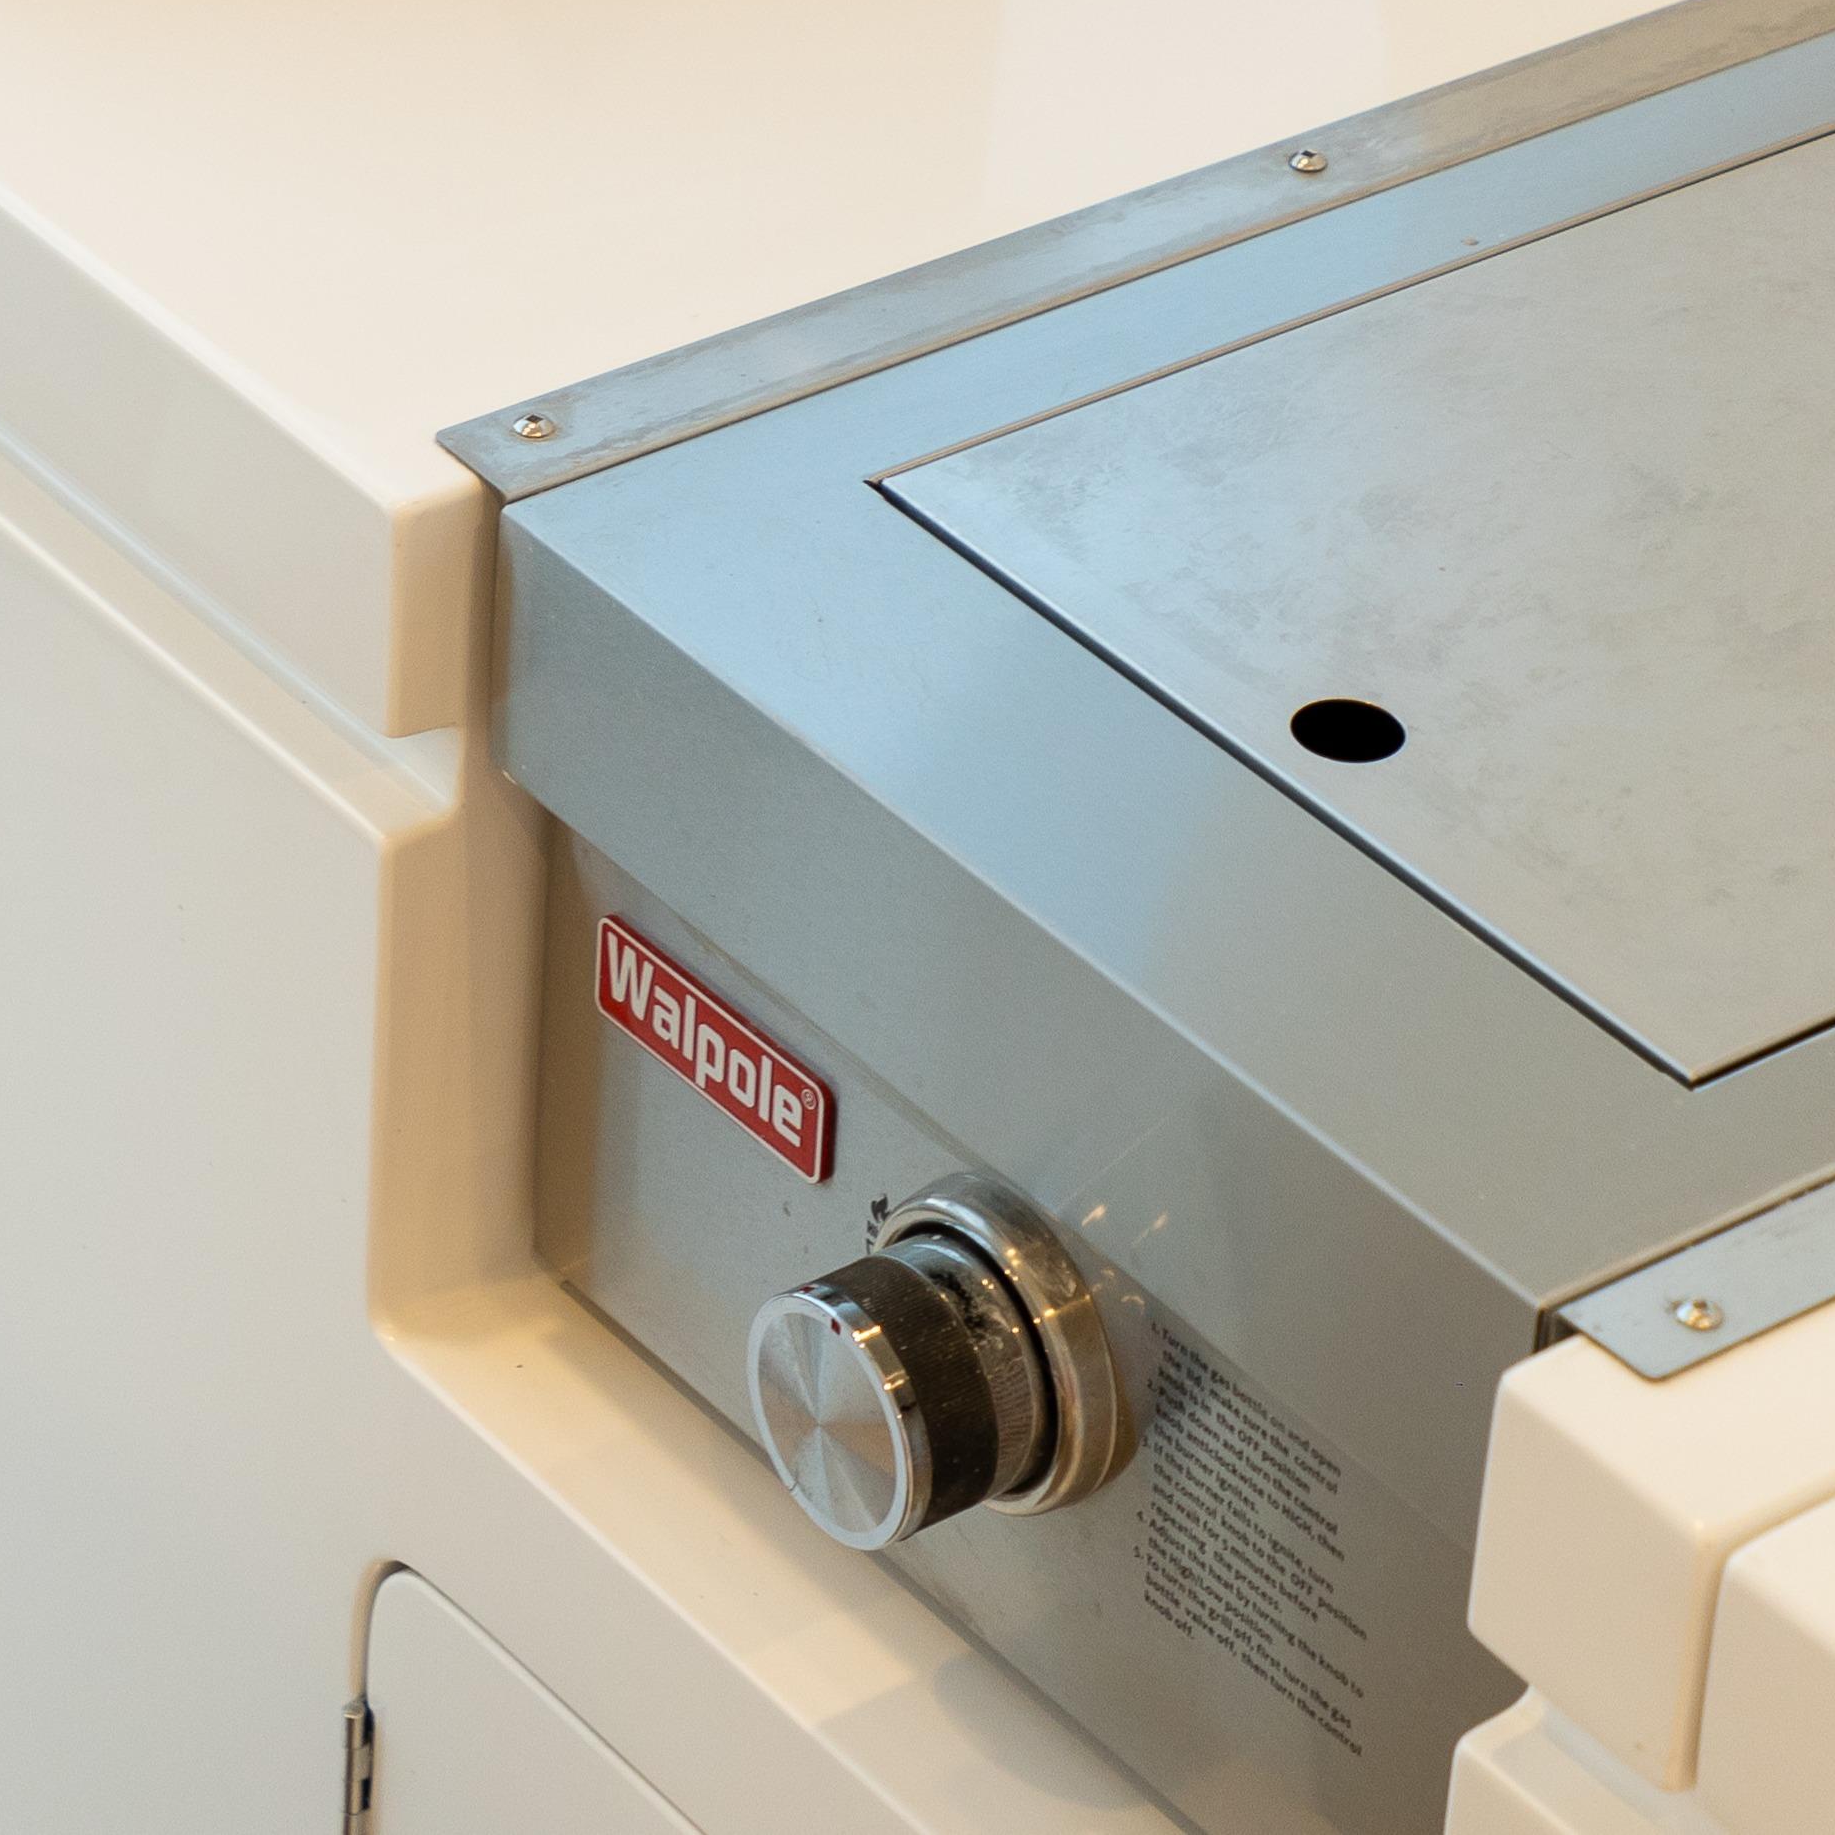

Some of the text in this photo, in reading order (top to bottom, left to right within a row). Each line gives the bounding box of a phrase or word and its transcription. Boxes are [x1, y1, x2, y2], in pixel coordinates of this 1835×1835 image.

[1154, 1423, 1172, 1445] the
[1175, 1439, 1213, 1475] burner
[1158, 1367, 1187, 1395] knob
[1216, 1413, 1235, 1433] the
[1237, 1430, 1259, 1450] OFF
[1262, 1451, 1309, 1492] position
[1158, 1386, 1185, 1413] Push
[1188, 1412, 1219, 1441] down
[1222, 1439, 1243, 1460] and
[1245, 1456, 1270, 1481] turn
[1272, 1478, 1291, 1499] the
[1294, 1497, 1337, 1534] control
[1162, 1328, 1187, 1355] Turn
[1190, 1351, 1208, 1372] the
[1210, 1370, 1229, 1389] gas
[1232, 1383, 1267, 1419] bottle
[1288, 1430, 1309, 1451] and
[1311, 1449, 1340, 1476] open
[1163, 1350, 1181, 1371] the
[1209, 1389, 1239, 1417] make
[1243, 1415, 1267, 1439] sure
[1270, 1435, 1288, 1456] the
[1294, 1456, 1337, 1493] control
[1151, 1502, 1205, 1553] repeating
[1213, 1551, 1232, 1572] the
[1152, 1483, 1173, 1504] and
[1176, 1503, 1199, 1526] wait
[1203, 1520, 1219, 1540] for
[1230, 1546, 1276, 1587] minutes
[1279, 1583, 1317, 1621] before
[1154, 1402, 1183, 1432] knob
[1187, 1433, 1263, 1496] anticlockwise
[1317, 1534, 1344, 1560] then
[1154, 1463, 1172, 1484] the
[1175, 1482, 1216, 1518] control
[1221, 1515, 1249, 1545] knob
[1266, 1554, 1285, 1575] the
[1290, 1573, 1312, 1594] OFF
[1318, 1597, 1366, 1639] position
[1165, 1453, 1183, 1473] the
[1186, 1467, 1223, 1504] burner
[1227, 1501, 1251, 1527] fails
[1308, 1567, 1333, 1593] turn
[1144, 1590, 1172, 1620] knob
[1148, 1537, 1166, 1558] the
[1225, 1602, 1272, 1643] position
[1149, 1519, 1184, 1553] Adjust
[1188, 1550, 1206, 1570] the
[1208, 1565, 1233, 1592] heat
[1252, 1602, 1294, 1645] turning
[1297, 1639, 1316, 1660] the
[1319, 1655, 1348, 1685] knob
[1161, 1567, 1185, 1592] turn
[1187, 1589, 1206, 1609] the
[1208, 1607, 1232, 1630] grill
[1256, 1644, 1280, 1670] first
[1283, 1667, 1307, 1692] turn
[1310, 1689, 1328, 1709] the
[1331, 1708, 1351, 1728] gas
[1145, 1572, 1179, 1607] bottle
[1185, 1608, 1214, 1635] valve
[1241, 1653, 1267, 1679] then
[1270, 1676, 1294, 1702] turn
[1297, 1698, 1315, 1718] the
[1318, 1717, 1361, 1756] control
